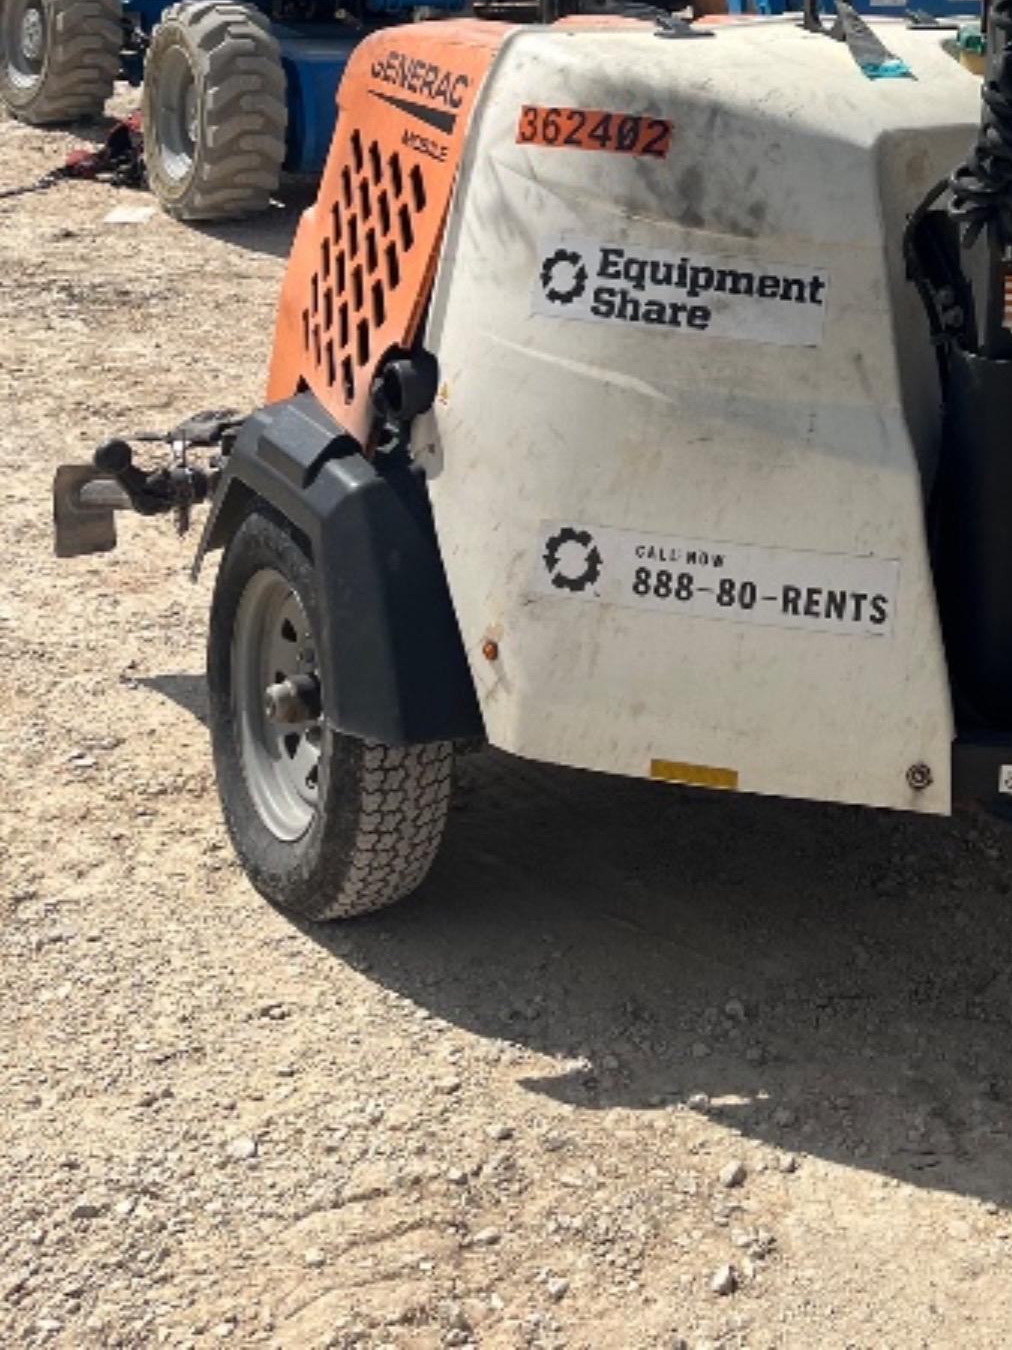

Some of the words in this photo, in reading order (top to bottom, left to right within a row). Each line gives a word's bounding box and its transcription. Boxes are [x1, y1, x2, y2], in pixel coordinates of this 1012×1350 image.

[371, 51, 470, 108] GENERAC
[519, 106, 671, 157] 362402
[596, 247, 826, 306] Equipment
[590, 286, 712, 331] Share
[634, 545, 678, 563] CALL
[686, 550, 726, 568] NOW
[632, 566, 888, 625] 888-80-RENTS
